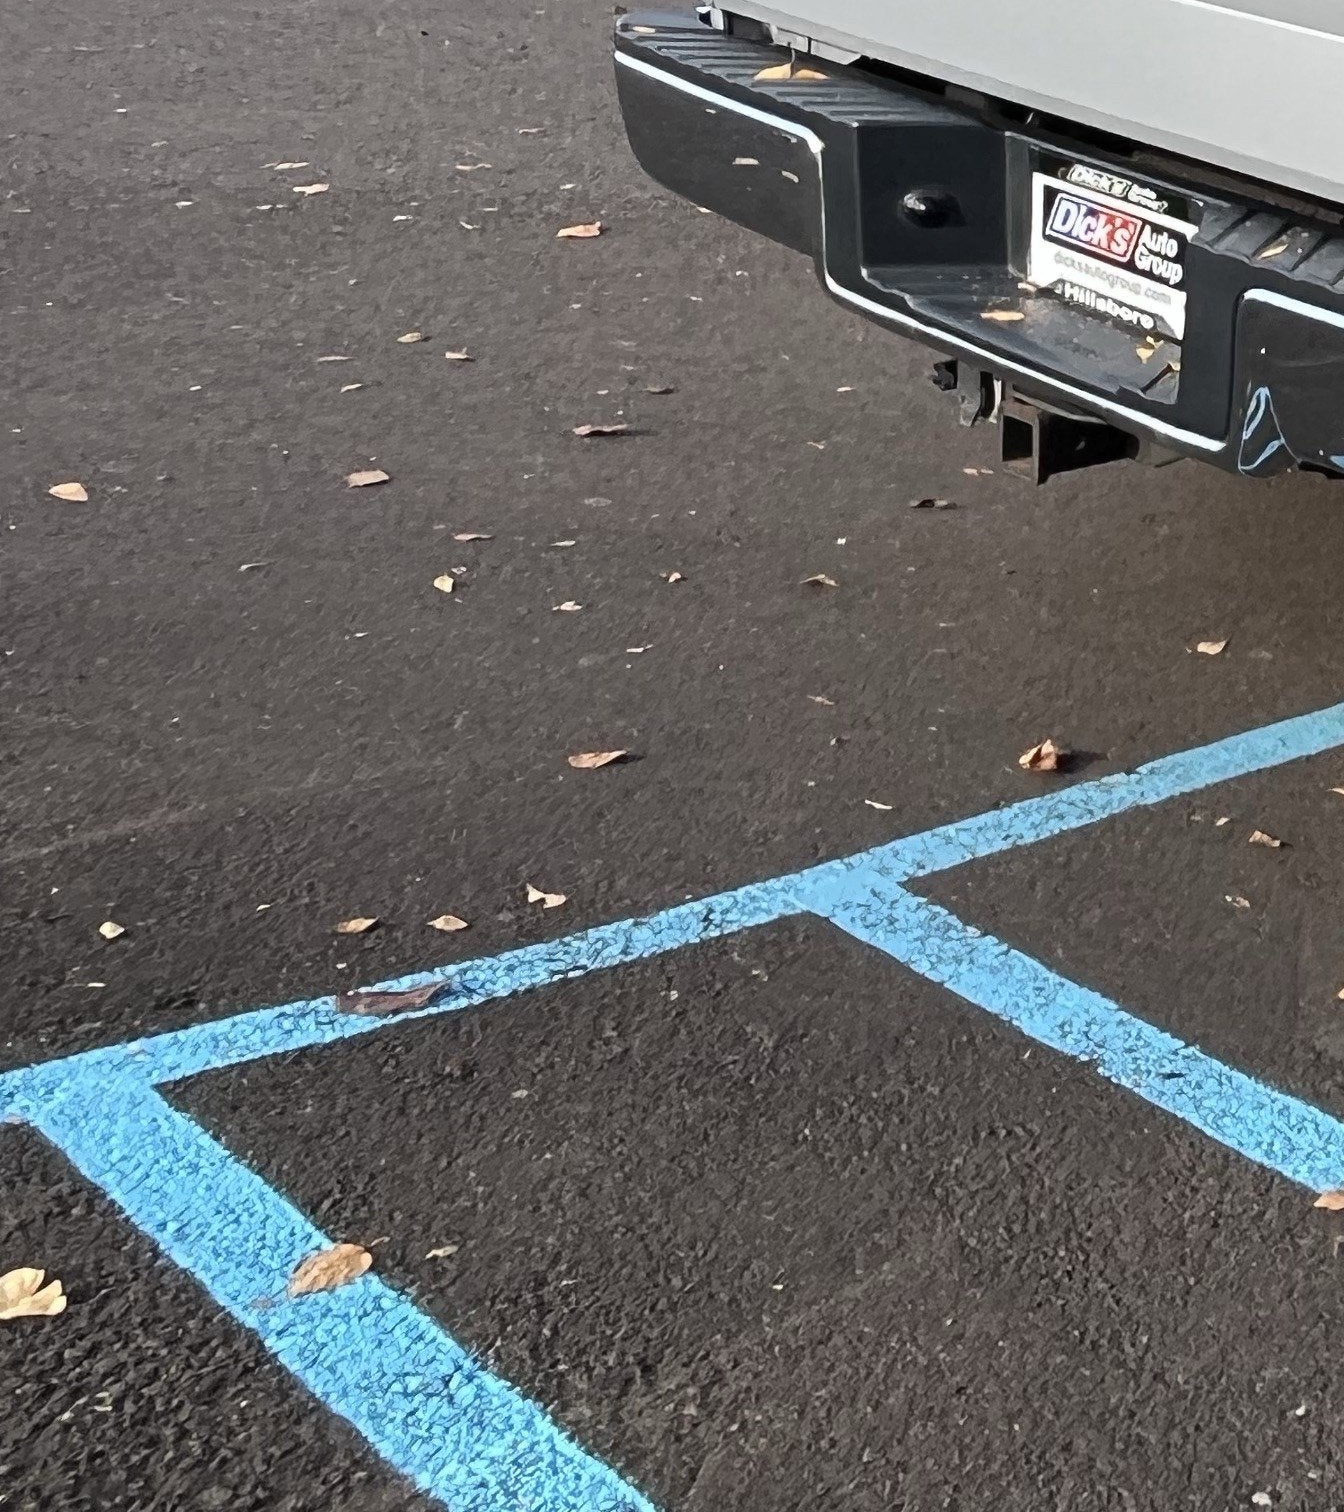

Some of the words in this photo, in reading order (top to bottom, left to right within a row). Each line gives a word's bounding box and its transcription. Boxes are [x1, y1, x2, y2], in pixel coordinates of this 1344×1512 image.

[1140, 224, 1178, 259] Auto
[1134, 245, 1183, 286] Group
[1064, 282, 1155, 330] Hillsboro
